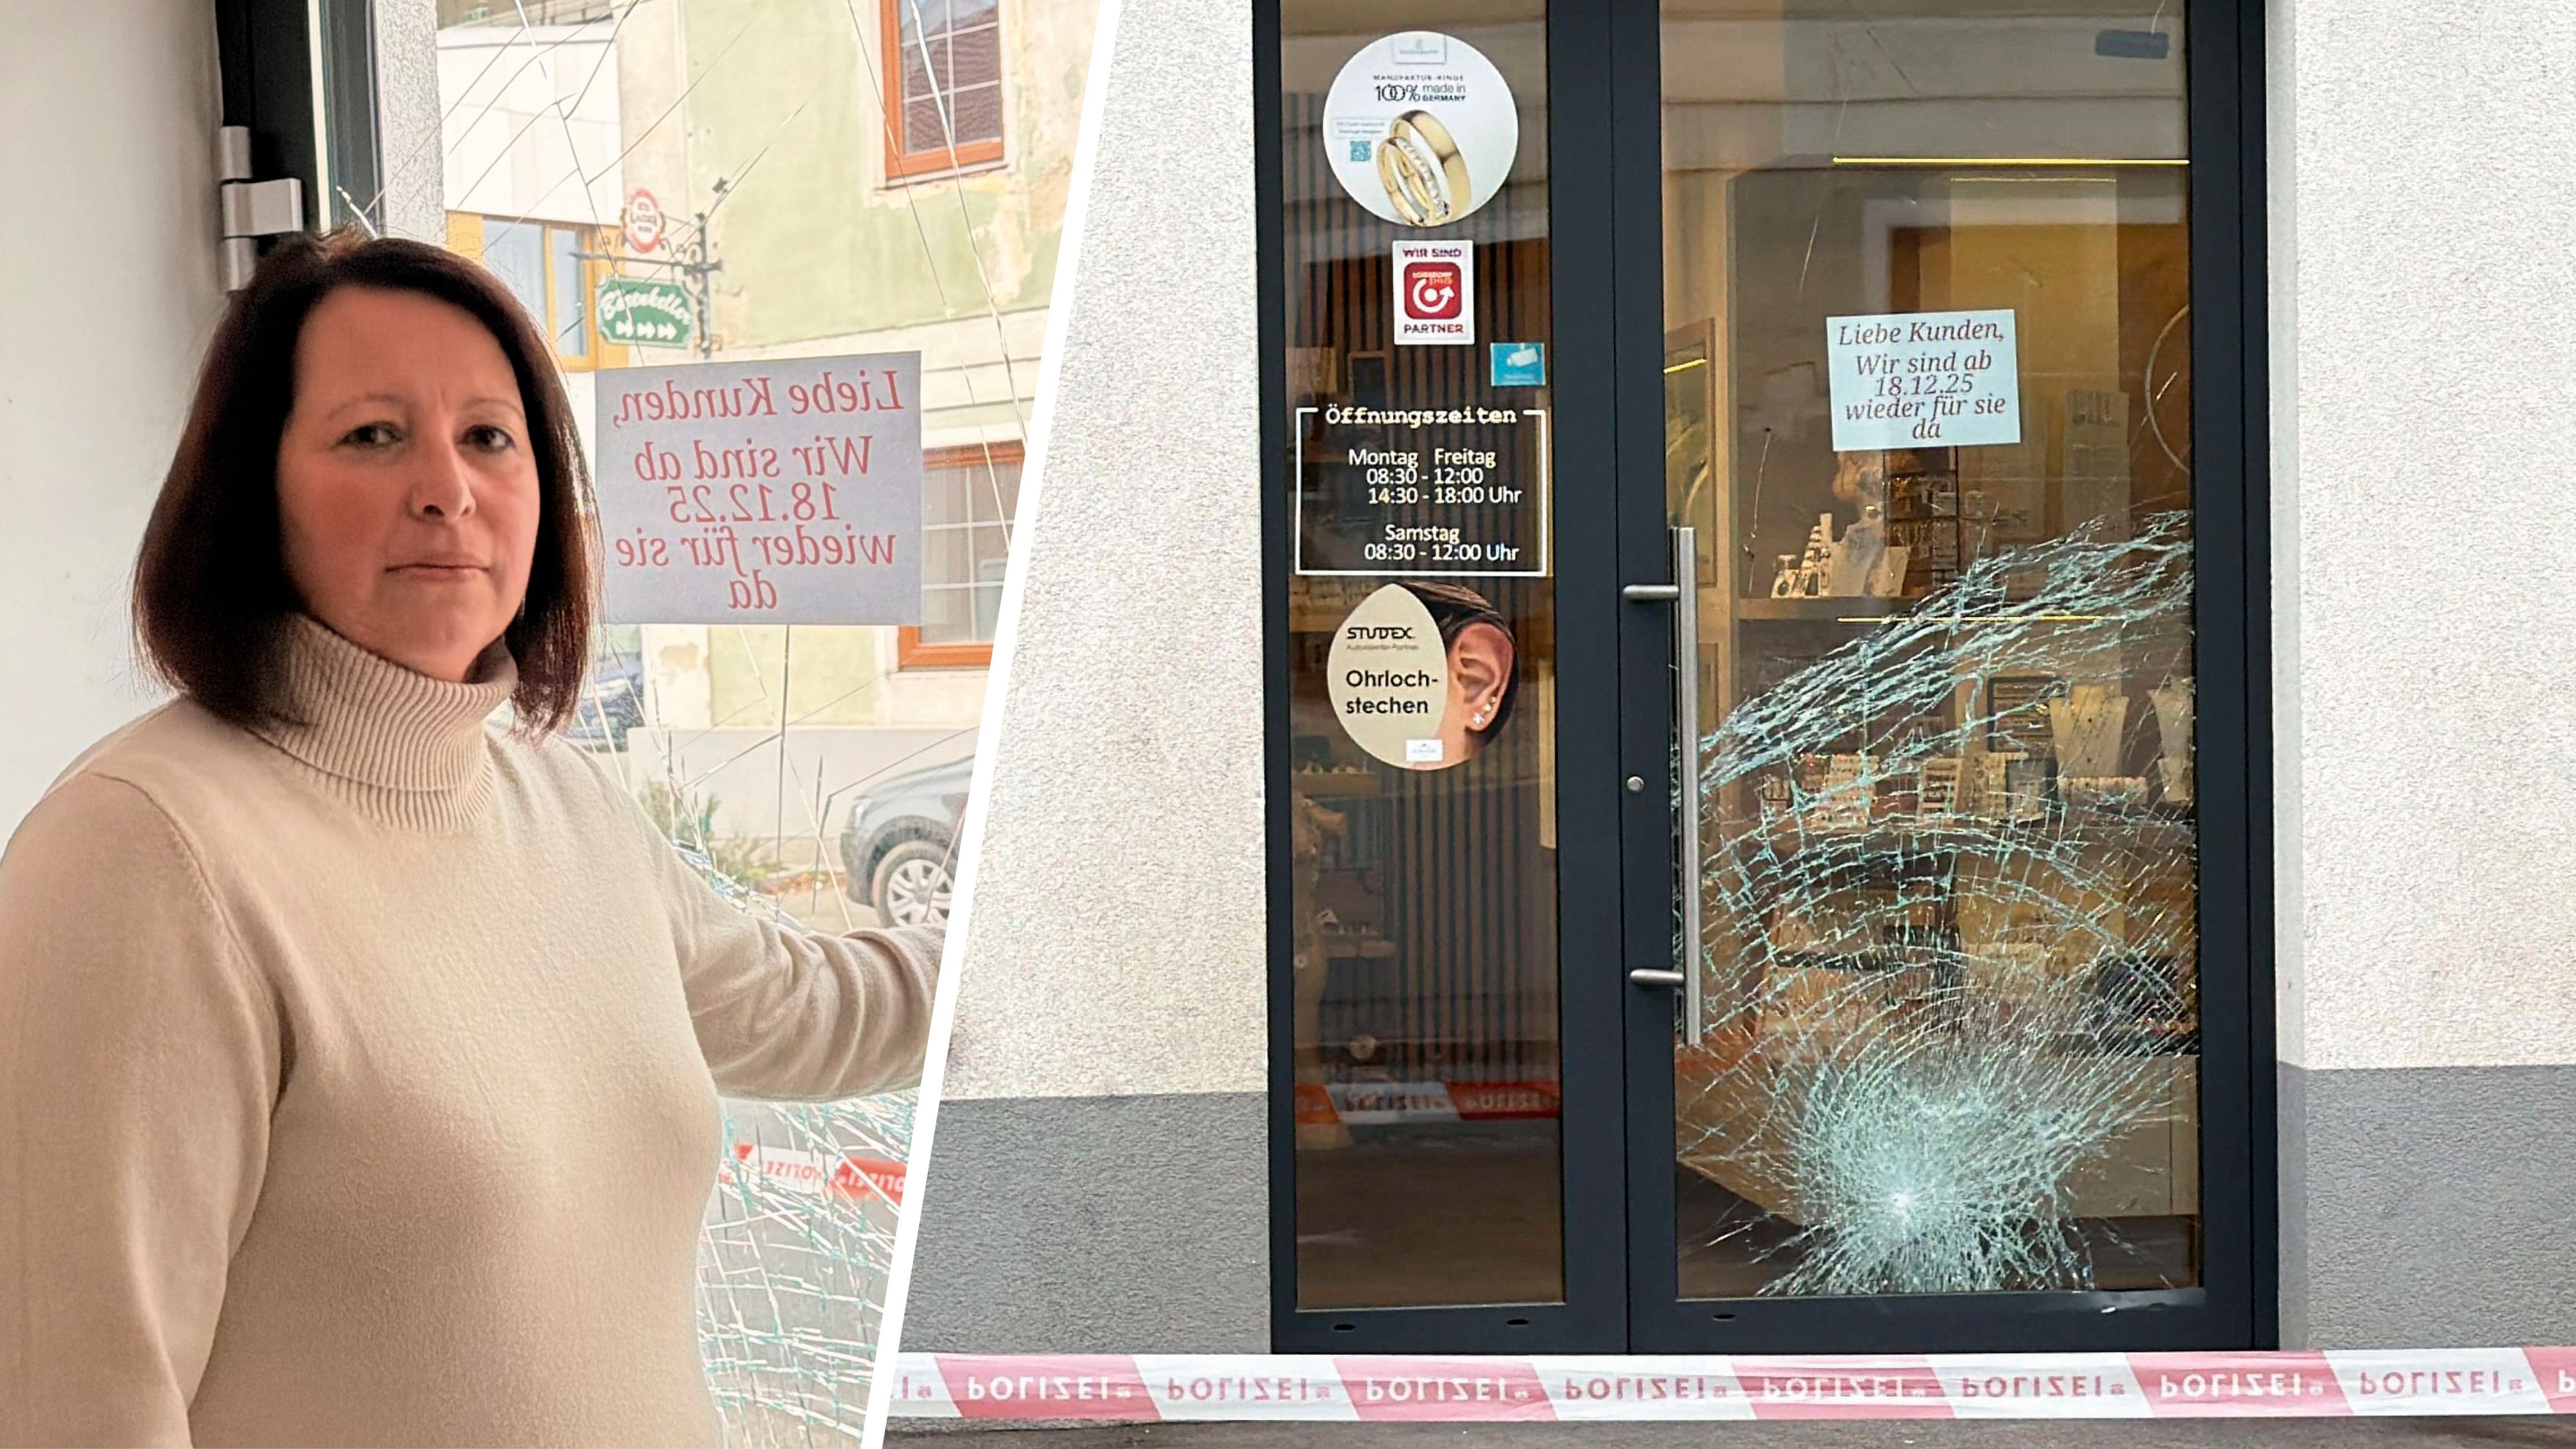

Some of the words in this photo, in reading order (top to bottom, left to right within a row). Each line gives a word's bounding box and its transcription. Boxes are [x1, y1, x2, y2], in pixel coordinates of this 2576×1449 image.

[1376, 84, 1420, 101] 100%
[1423, 82, 1454, 93] made
[1456, 83, 1466, 93] in
[1403, 248, 1428, 257] WIR
[1432, 248, 1462, 257] SIND
[1404, 324, 1464, 334] PARTNER
[1839, 324, 1901, 345] Liebe
[1908, 319, 2004, 342] Kunden,
[1857, 354, 1900, 375] Wir
[1908, 350, 1957, 374] sind
[1964, 349, 1992, 371] ab
[1874, 373, 1974, 397] 18.12.25
[1325, 404, 1517, 428] Öffnungszeiten
[1846, 394, 1926, 421] wieder
[1930, 395, 1968, 422] für
[1975, 393, 2006, 414] sie
[1913, 418, 1941, 440] da
[1349, 449, 1419, 468] Montag
[1434, 449, 1496, 468] Freitag
[1366, 468, 1417, 484] 08:30
[1434, 468, 1484, 484] 12:00
[1368, 488, 1418, 504] 14:30
[1434, 487, 1484, 504] 18:00
[1489, 486, 1522, 504] Uhr
[1385, 524, 1461, 545] Samstag
[1364, 544, 1415, 560] 08:30
[1432, 544, 1482, 560] 12:00
[1486, 543, 1520, 561] Uhr
[1347, 627, 1413, 639] STUDEX
[1346, 670, 1438, 687] Ohrloch-
[1346, 696, 1428, 714] stechen
